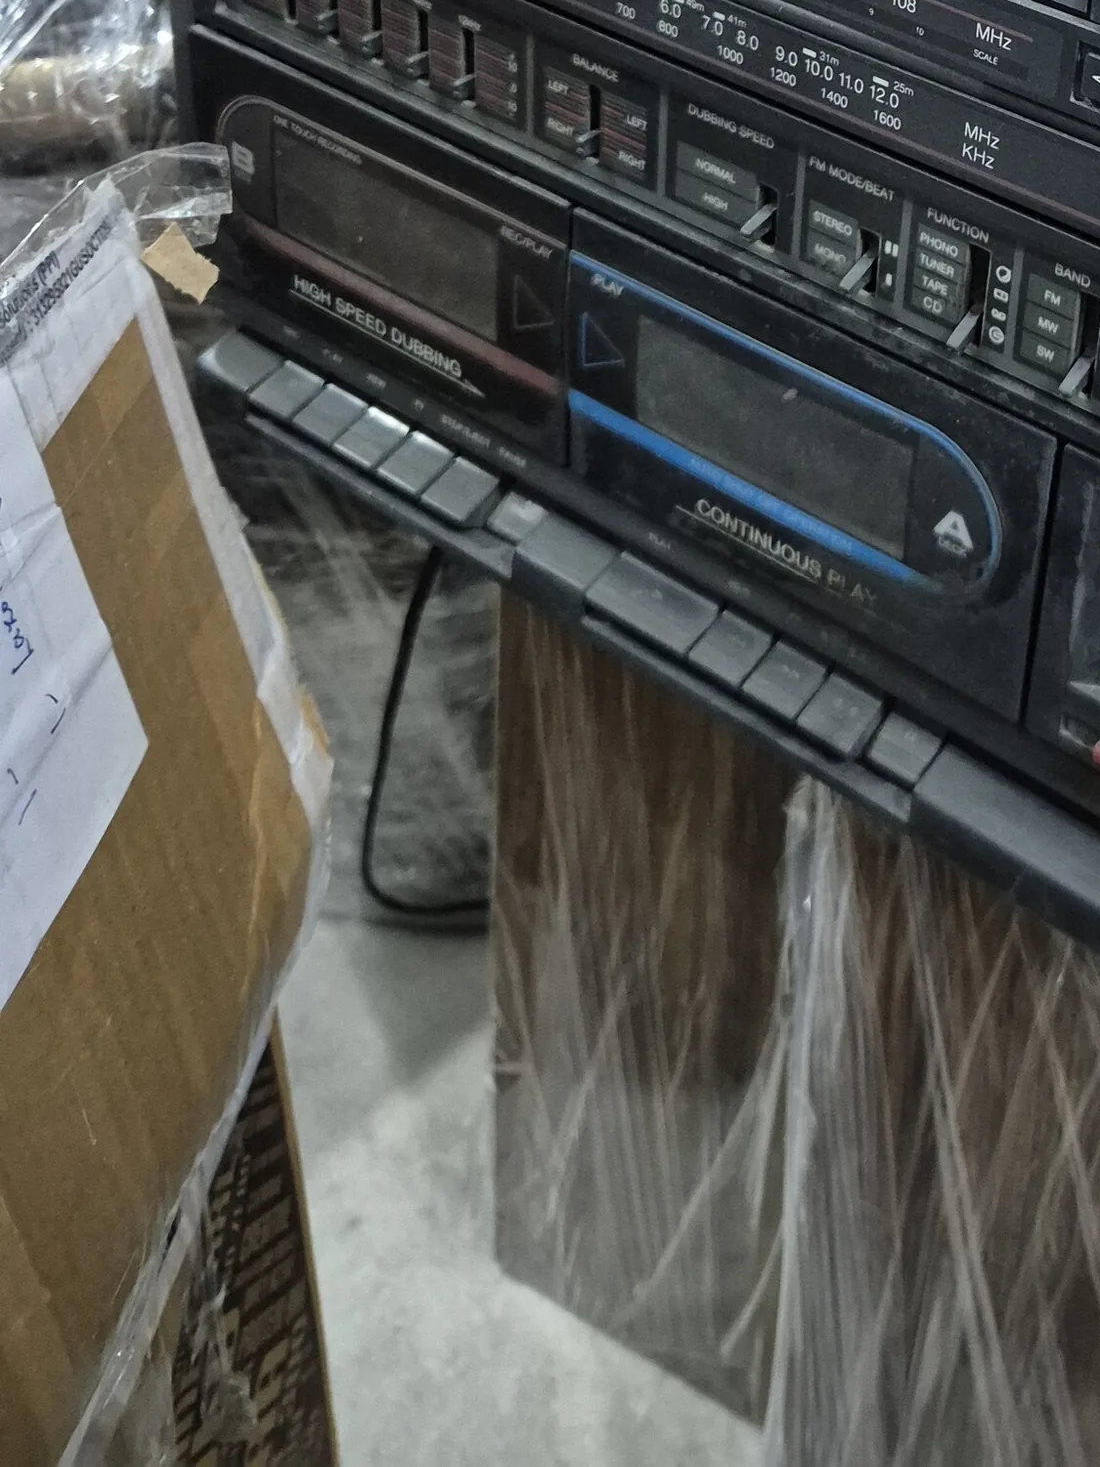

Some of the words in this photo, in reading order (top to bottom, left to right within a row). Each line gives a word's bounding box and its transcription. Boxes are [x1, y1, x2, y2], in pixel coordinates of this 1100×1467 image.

[728, 14, 747, 29] 41m
[975, 22, 1013, 51] MHz
[572, 53, 620, 83] BALANCE
[819, 50, 840, 66] 31m
[973, 48, 999, 66] SCALE
[615, 2, 636, 20] 700
[658, 19, 679, 38] 800
[717, 44, 744, 65] 1000
[770, 66, 797, 87] 1200
[820, 88, 848, 109] 1400
[873, 109, 901, 130] 1600
[962, 142, 996, 169] KHz
[702, 14, 724, 36] 7.0
[736, 29, 759, 51] 8.0
[775, 45, 798, 67] 9.0
[804, 59, 834, 81] 10.0
[839, 72, 864, 94] 11.0
[869, 85, 899, 109] 12.0
[964, 122, 1000, 150] MHz
[893, 81, 915, 97] 25m
[626, 114, 648, 131] LEFT
[687, 102, 737, 134] DUBBING
[738, 126, 776, 150] SPEED
[618, 150, 646, 171] RIGHT
[695, 157, 737, 185] NORMAL
[808, 155, 827, 174] FM
[828, 163, 896, 202] MODE/BEAT
[703, 192, 729, 211] HIGH
[813, 209, 853, 236] STEREO
[926, 206, 990, 244] FUNCTION
[919, 232, 959, 258] PHONO
[919, 253, 955, 279] TUNER
[1054, 262, 1091, 288] BAND
[921, 274, 948, 296] TAPE
[1043, 289, 1061, 307] FM
[923, 296, 943, 314] CD
[294, 274, 331, 308] HIGH
[335, 294, 387, 337] SPEED
[391, 327, 463, 378] DUBBING
[1037, 315, 1060, 335] MW
[1036, 344, 1055, 362] SW
[695, 498, 823, 580] CONTINUOUS
